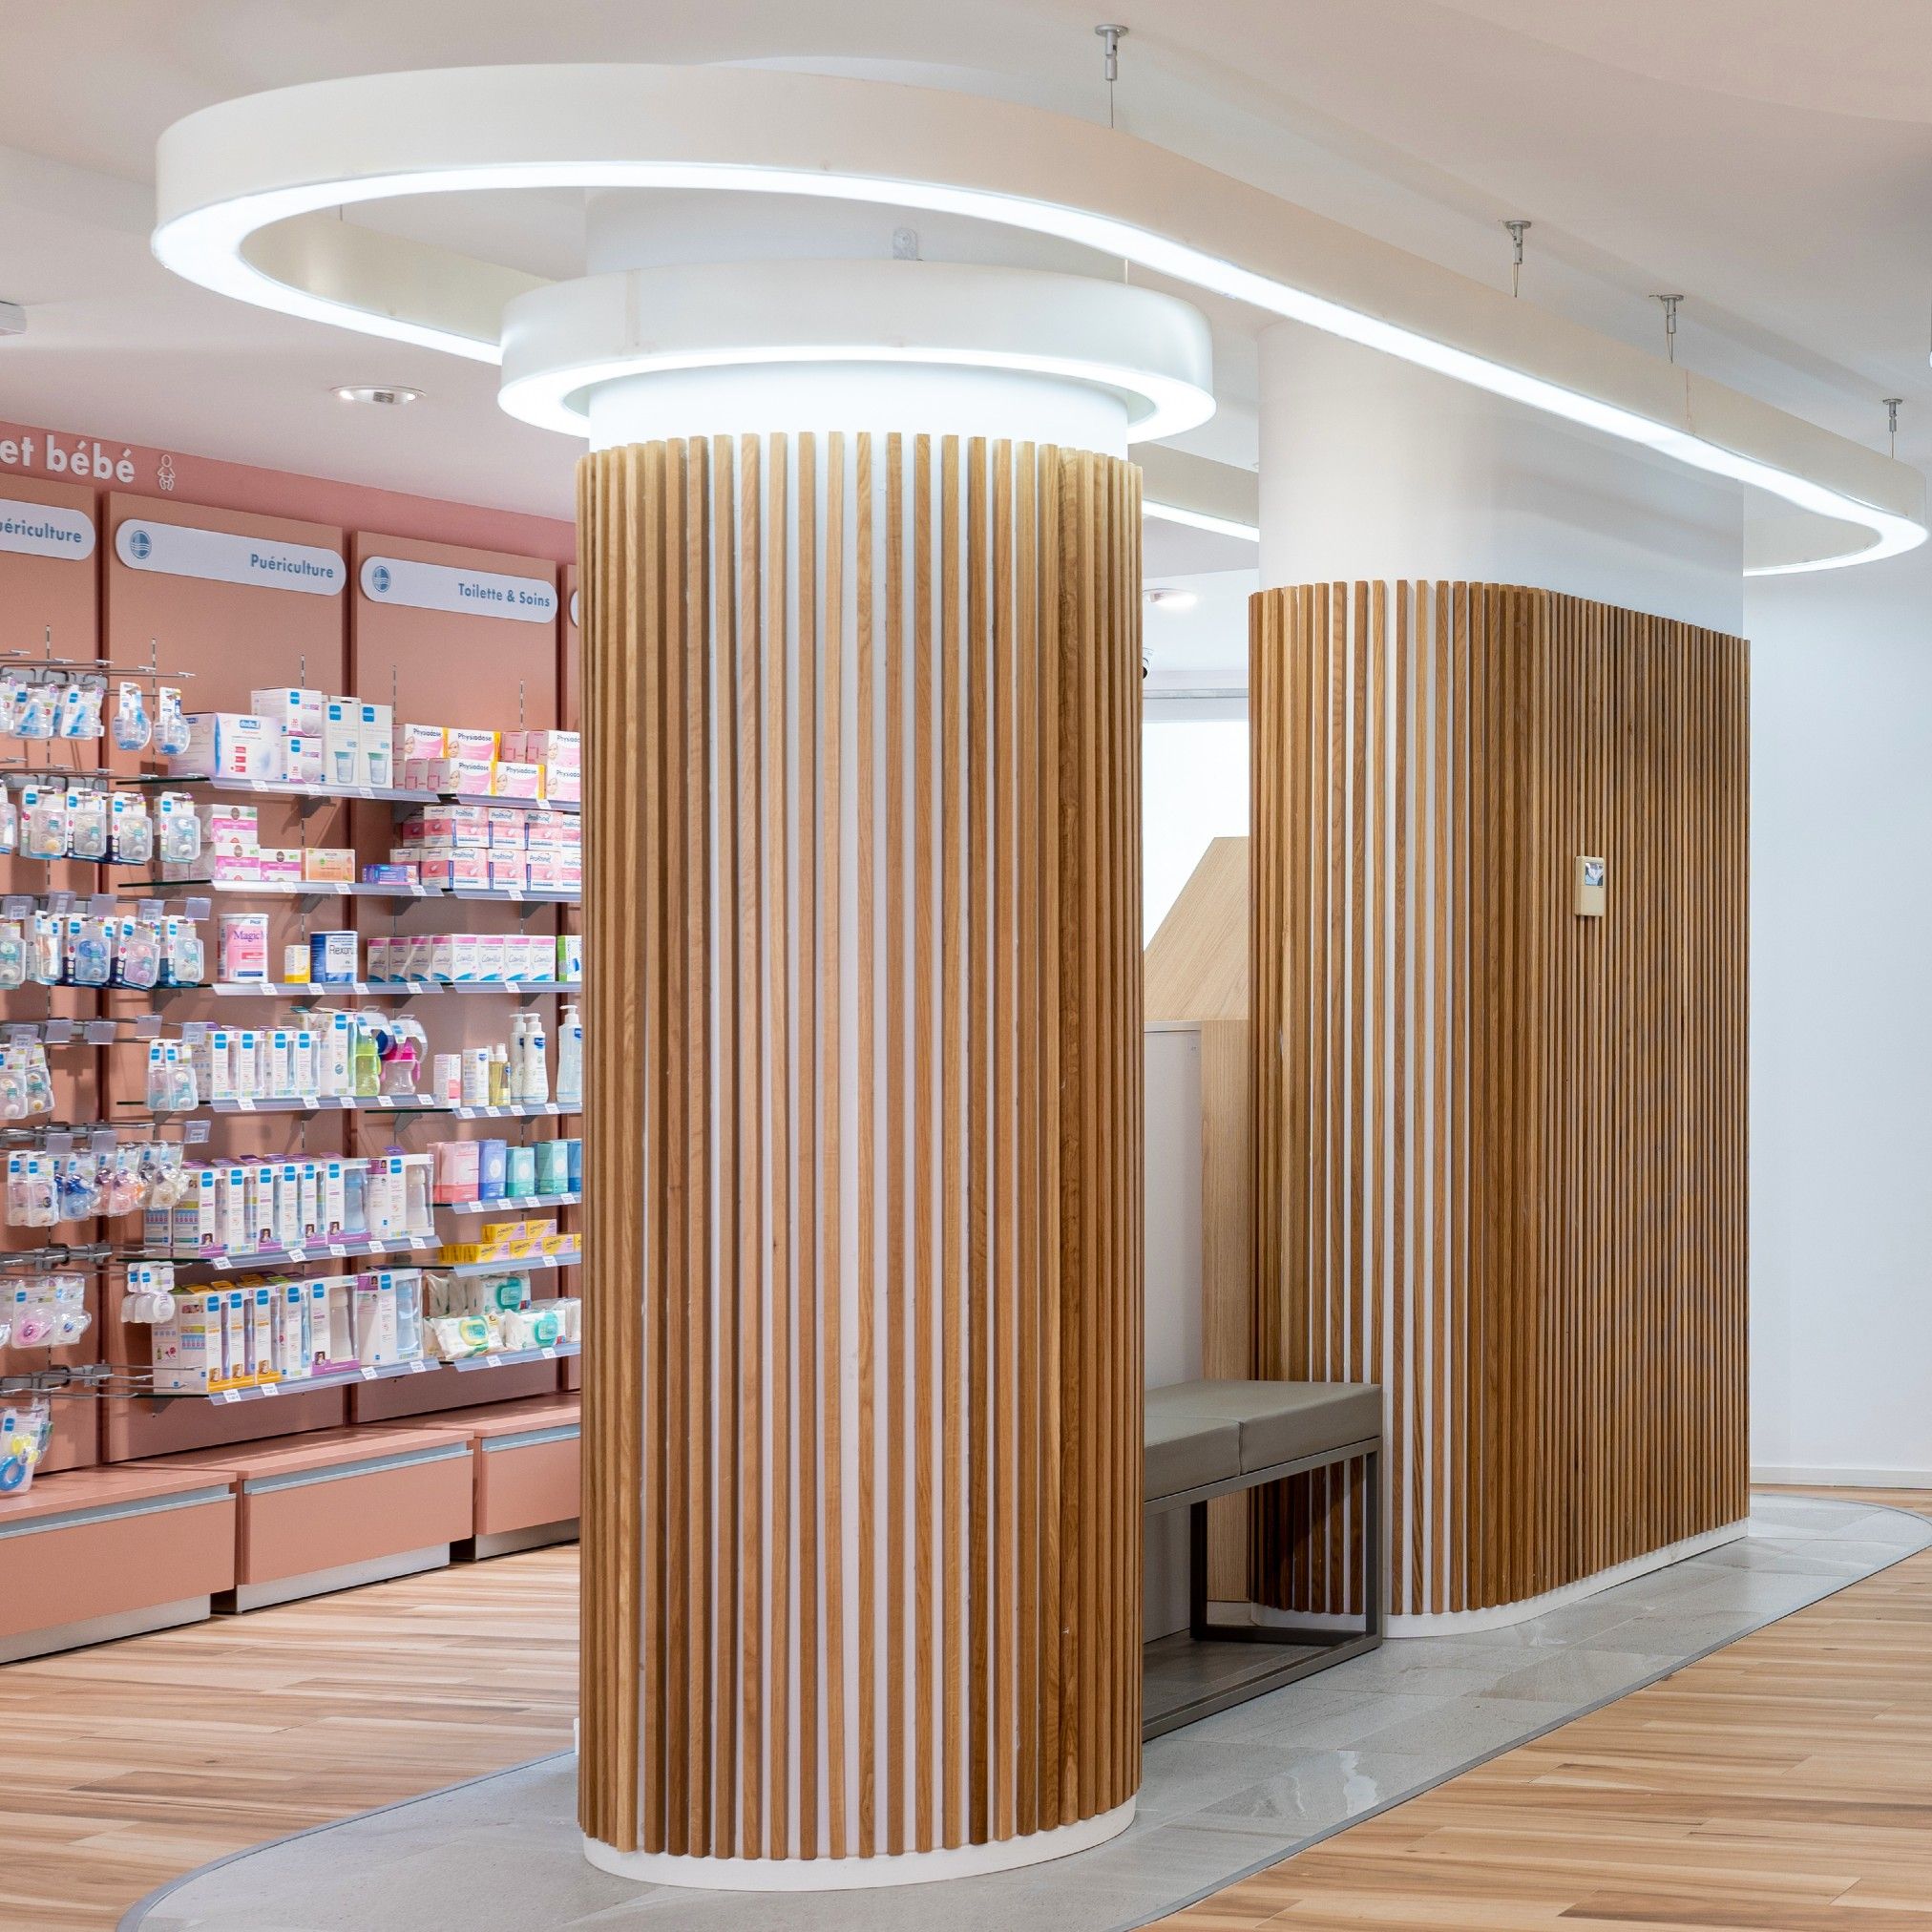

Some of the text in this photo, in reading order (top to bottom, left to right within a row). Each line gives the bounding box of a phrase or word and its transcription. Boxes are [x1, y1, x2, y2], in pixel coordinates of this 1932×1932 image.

[0, 434, 135, 483] et bébé
[0, 517, 82, 543] ériculture
[250, 554, 334, 578] Puériculture
[458, 582, 551, 607] Toilette & Soins
[458, 732, 492, 742] Physiodose
